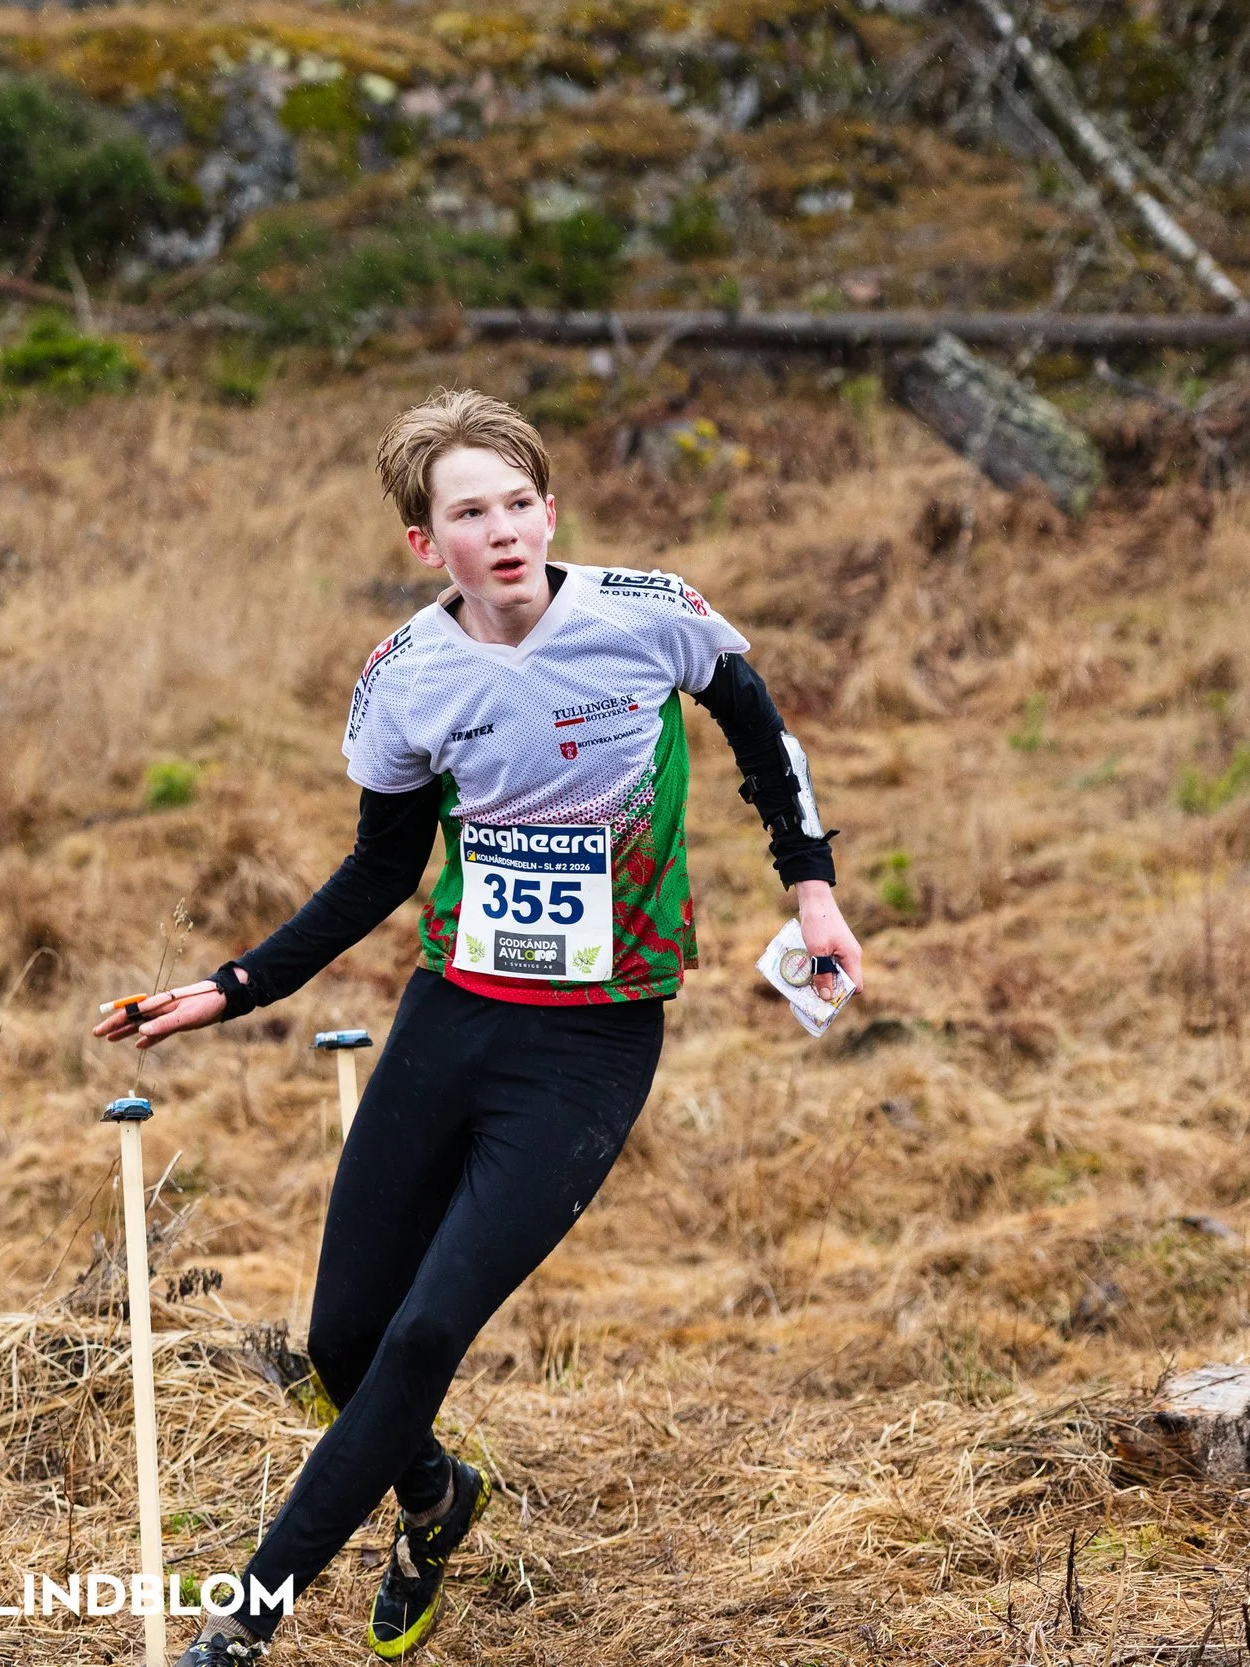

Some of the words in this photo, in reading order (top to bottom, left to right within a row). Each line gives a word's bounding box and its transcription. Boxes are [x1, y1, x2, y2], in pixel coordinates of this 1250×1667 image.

[600, 589, 676, 603] MOUNTAIN
[368, 669, 381, 693] BIKE
[384, 643, 414, 666] RACE
[553, 698, 619, 720] TULLINGE
[620, 694, 636, 705] SK
[585, 706, 628, 722] BOTKYRKA
[577, 736, 612, 748] BOTKYRKA
[613, 727, 643, 741] KOMMUN
[464, 824, 605, 854] bagheera
[476, 854, 537, 870] KOLMÅRDSMEDELN
[543, 863, 554, 871] SL
[555, 863, 567, 871] #2
[569, 863, 591, 871] 2026
[482, 873, 585, 925] 355
[498, 937, 558, 950] GODKÄNDA
